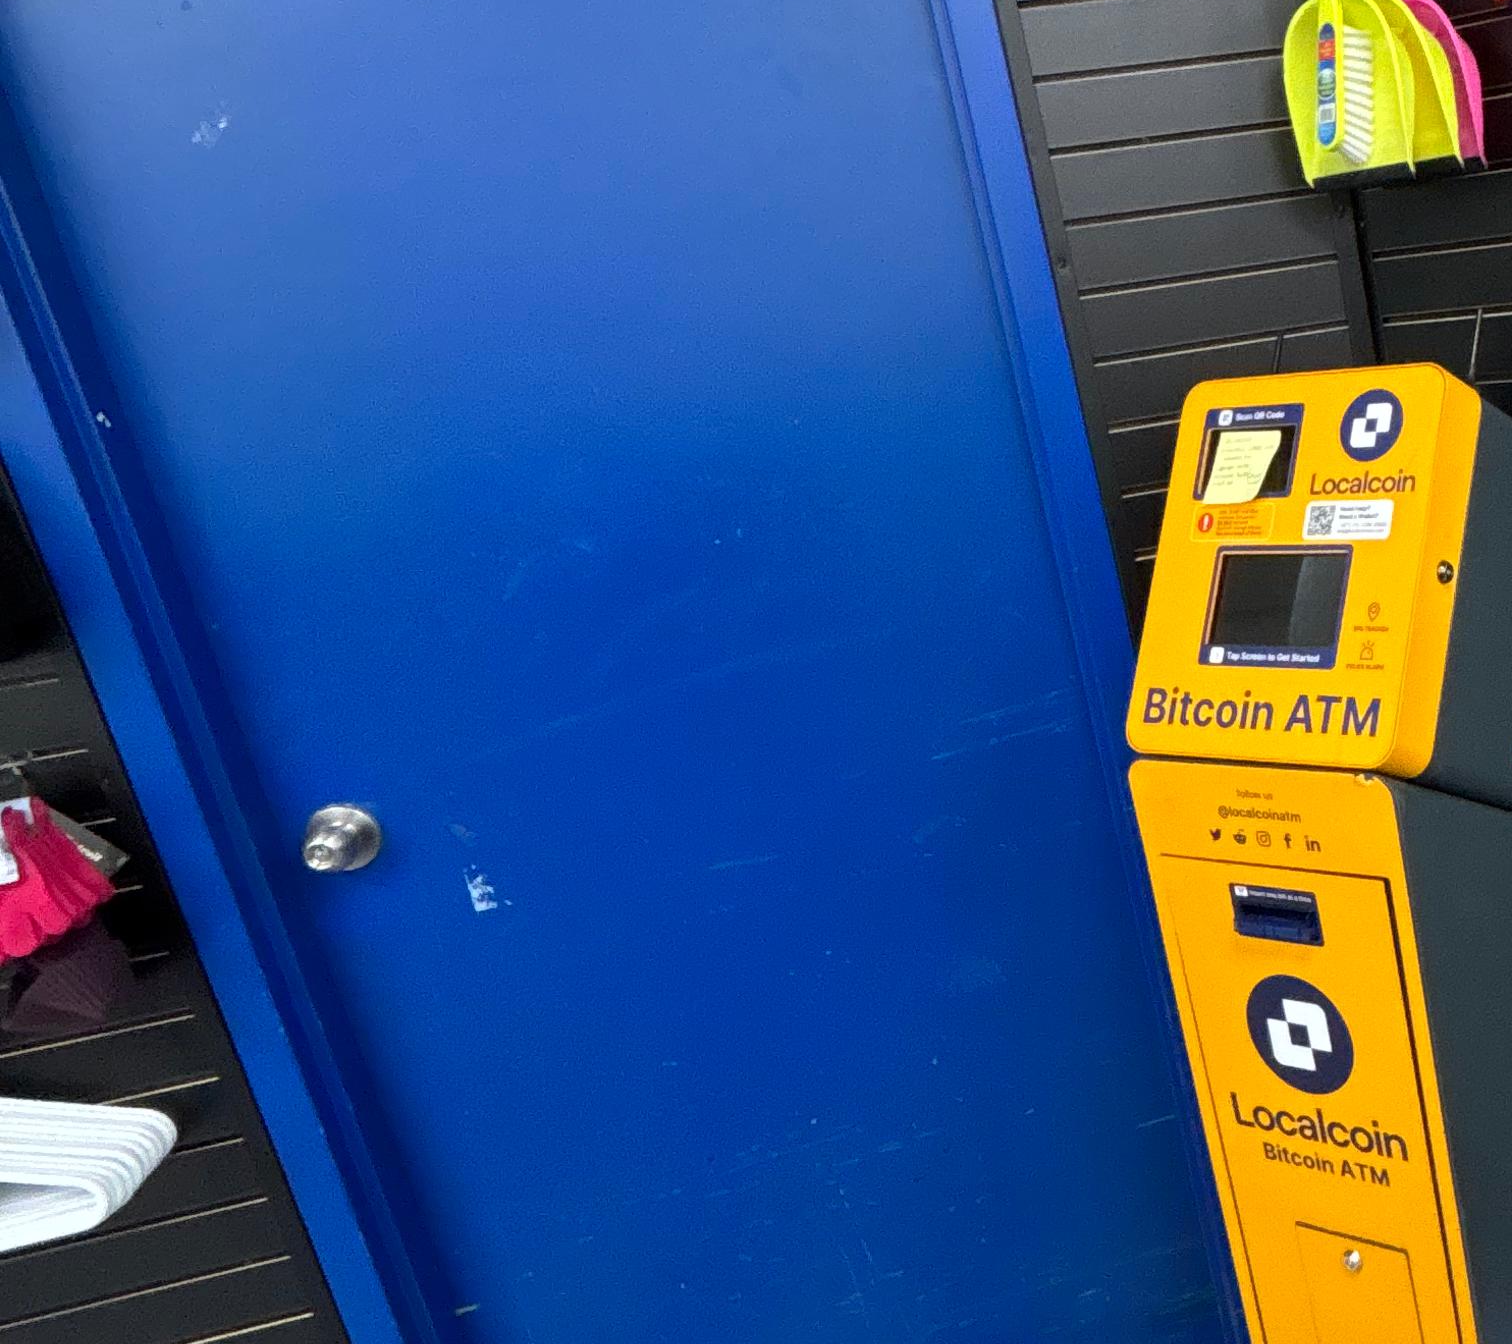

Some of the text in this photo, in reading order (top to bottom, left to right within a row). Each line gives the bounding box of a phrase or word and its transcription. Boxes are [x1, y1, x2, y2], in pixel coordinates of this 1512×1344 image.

[1265, 410, 1285, 420] Code
[1309, 469, 1416, 496] Localcoin
[1227, 651, 1321, 663] Tap Screen to Get Started
[1143, 686, 1382, 738] Bitcoin ATM
[1217, 805, 1302, 824] @localcoinatm
[1230, 1090, 1409, 1162] Localcoin
[1262, 1141, 1391, 1187] Bitcoin ATM
